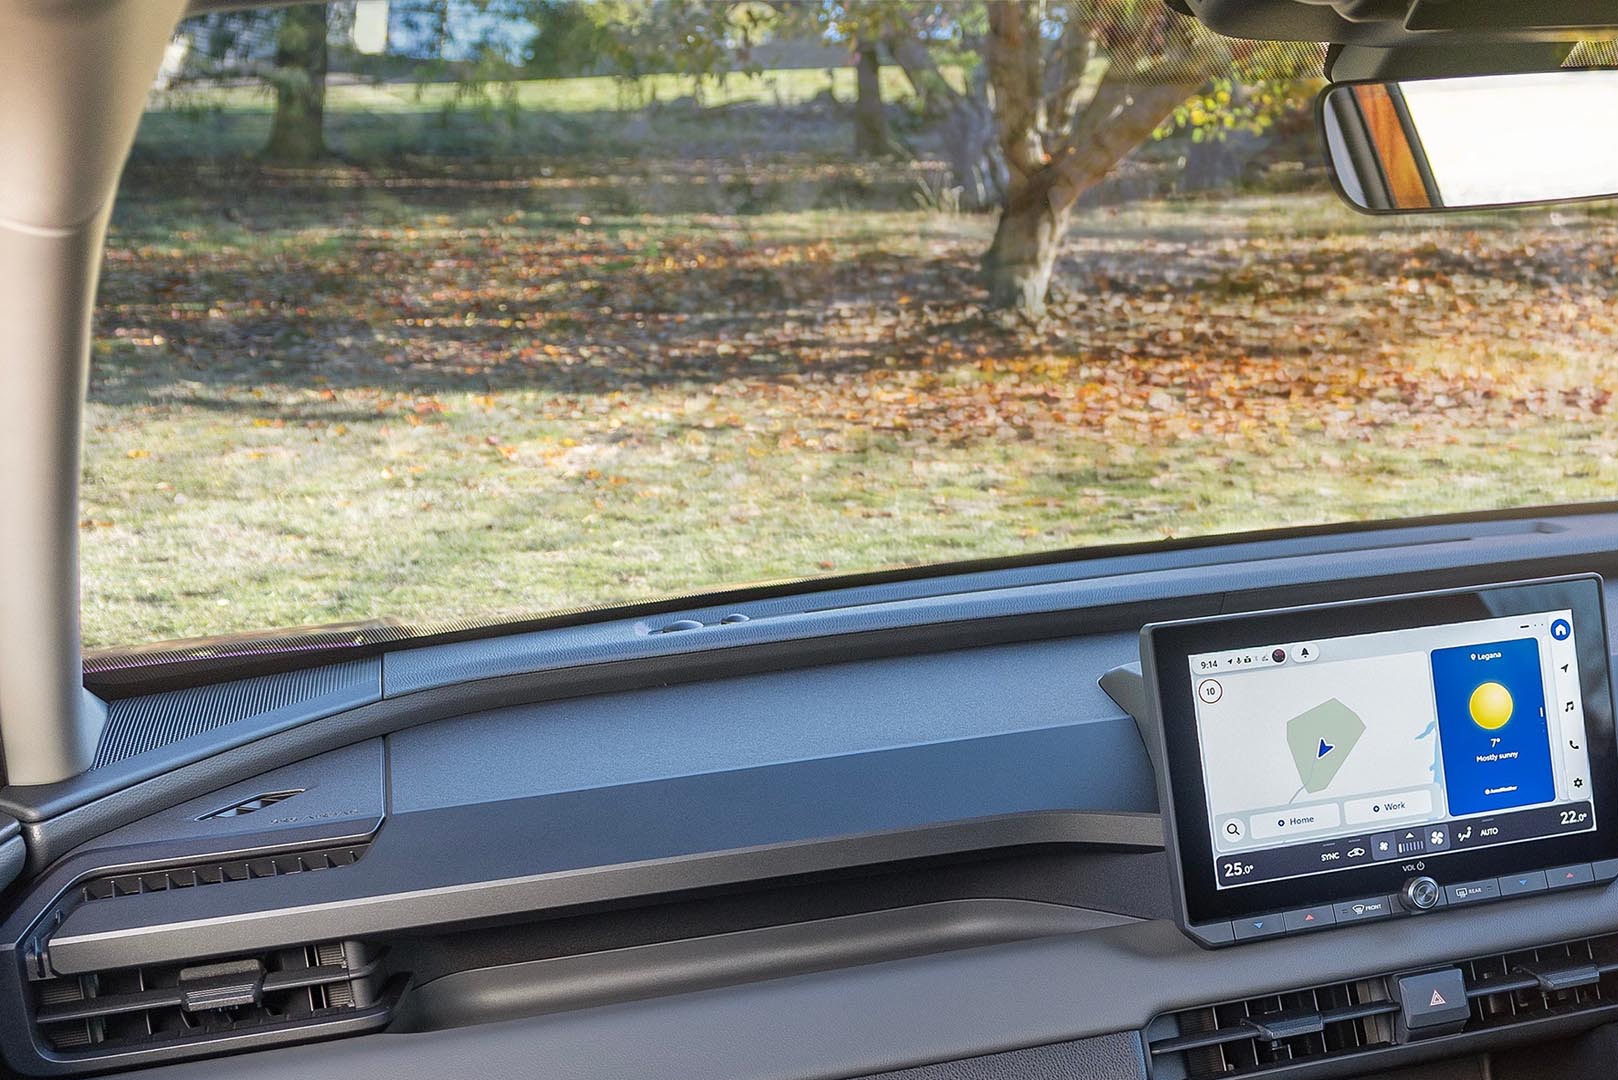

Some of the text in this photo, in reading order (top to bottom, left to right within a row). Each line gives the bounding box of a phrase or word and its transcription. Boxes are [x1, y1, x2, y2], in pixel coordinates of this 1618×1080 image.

[1477, 651, 1502, 661] Legana
[1200, 660, 1218, 670] 9:14
[1206, 687, 1215, 696] 10
[1476, 751, 1519, 763] Mostly sunny
[1384, 802, 1406, 812] Work
[1289, 815, 1315, 826] Home
[1480, 827, 1499, 837] AUTO
[1320, 852, 1340, 862] SYNC
[1401, 863, 1416, 872] VOL
[1468, 887, 1482, 895] REAR
[1365, 903, 1382, 912] FRONT
